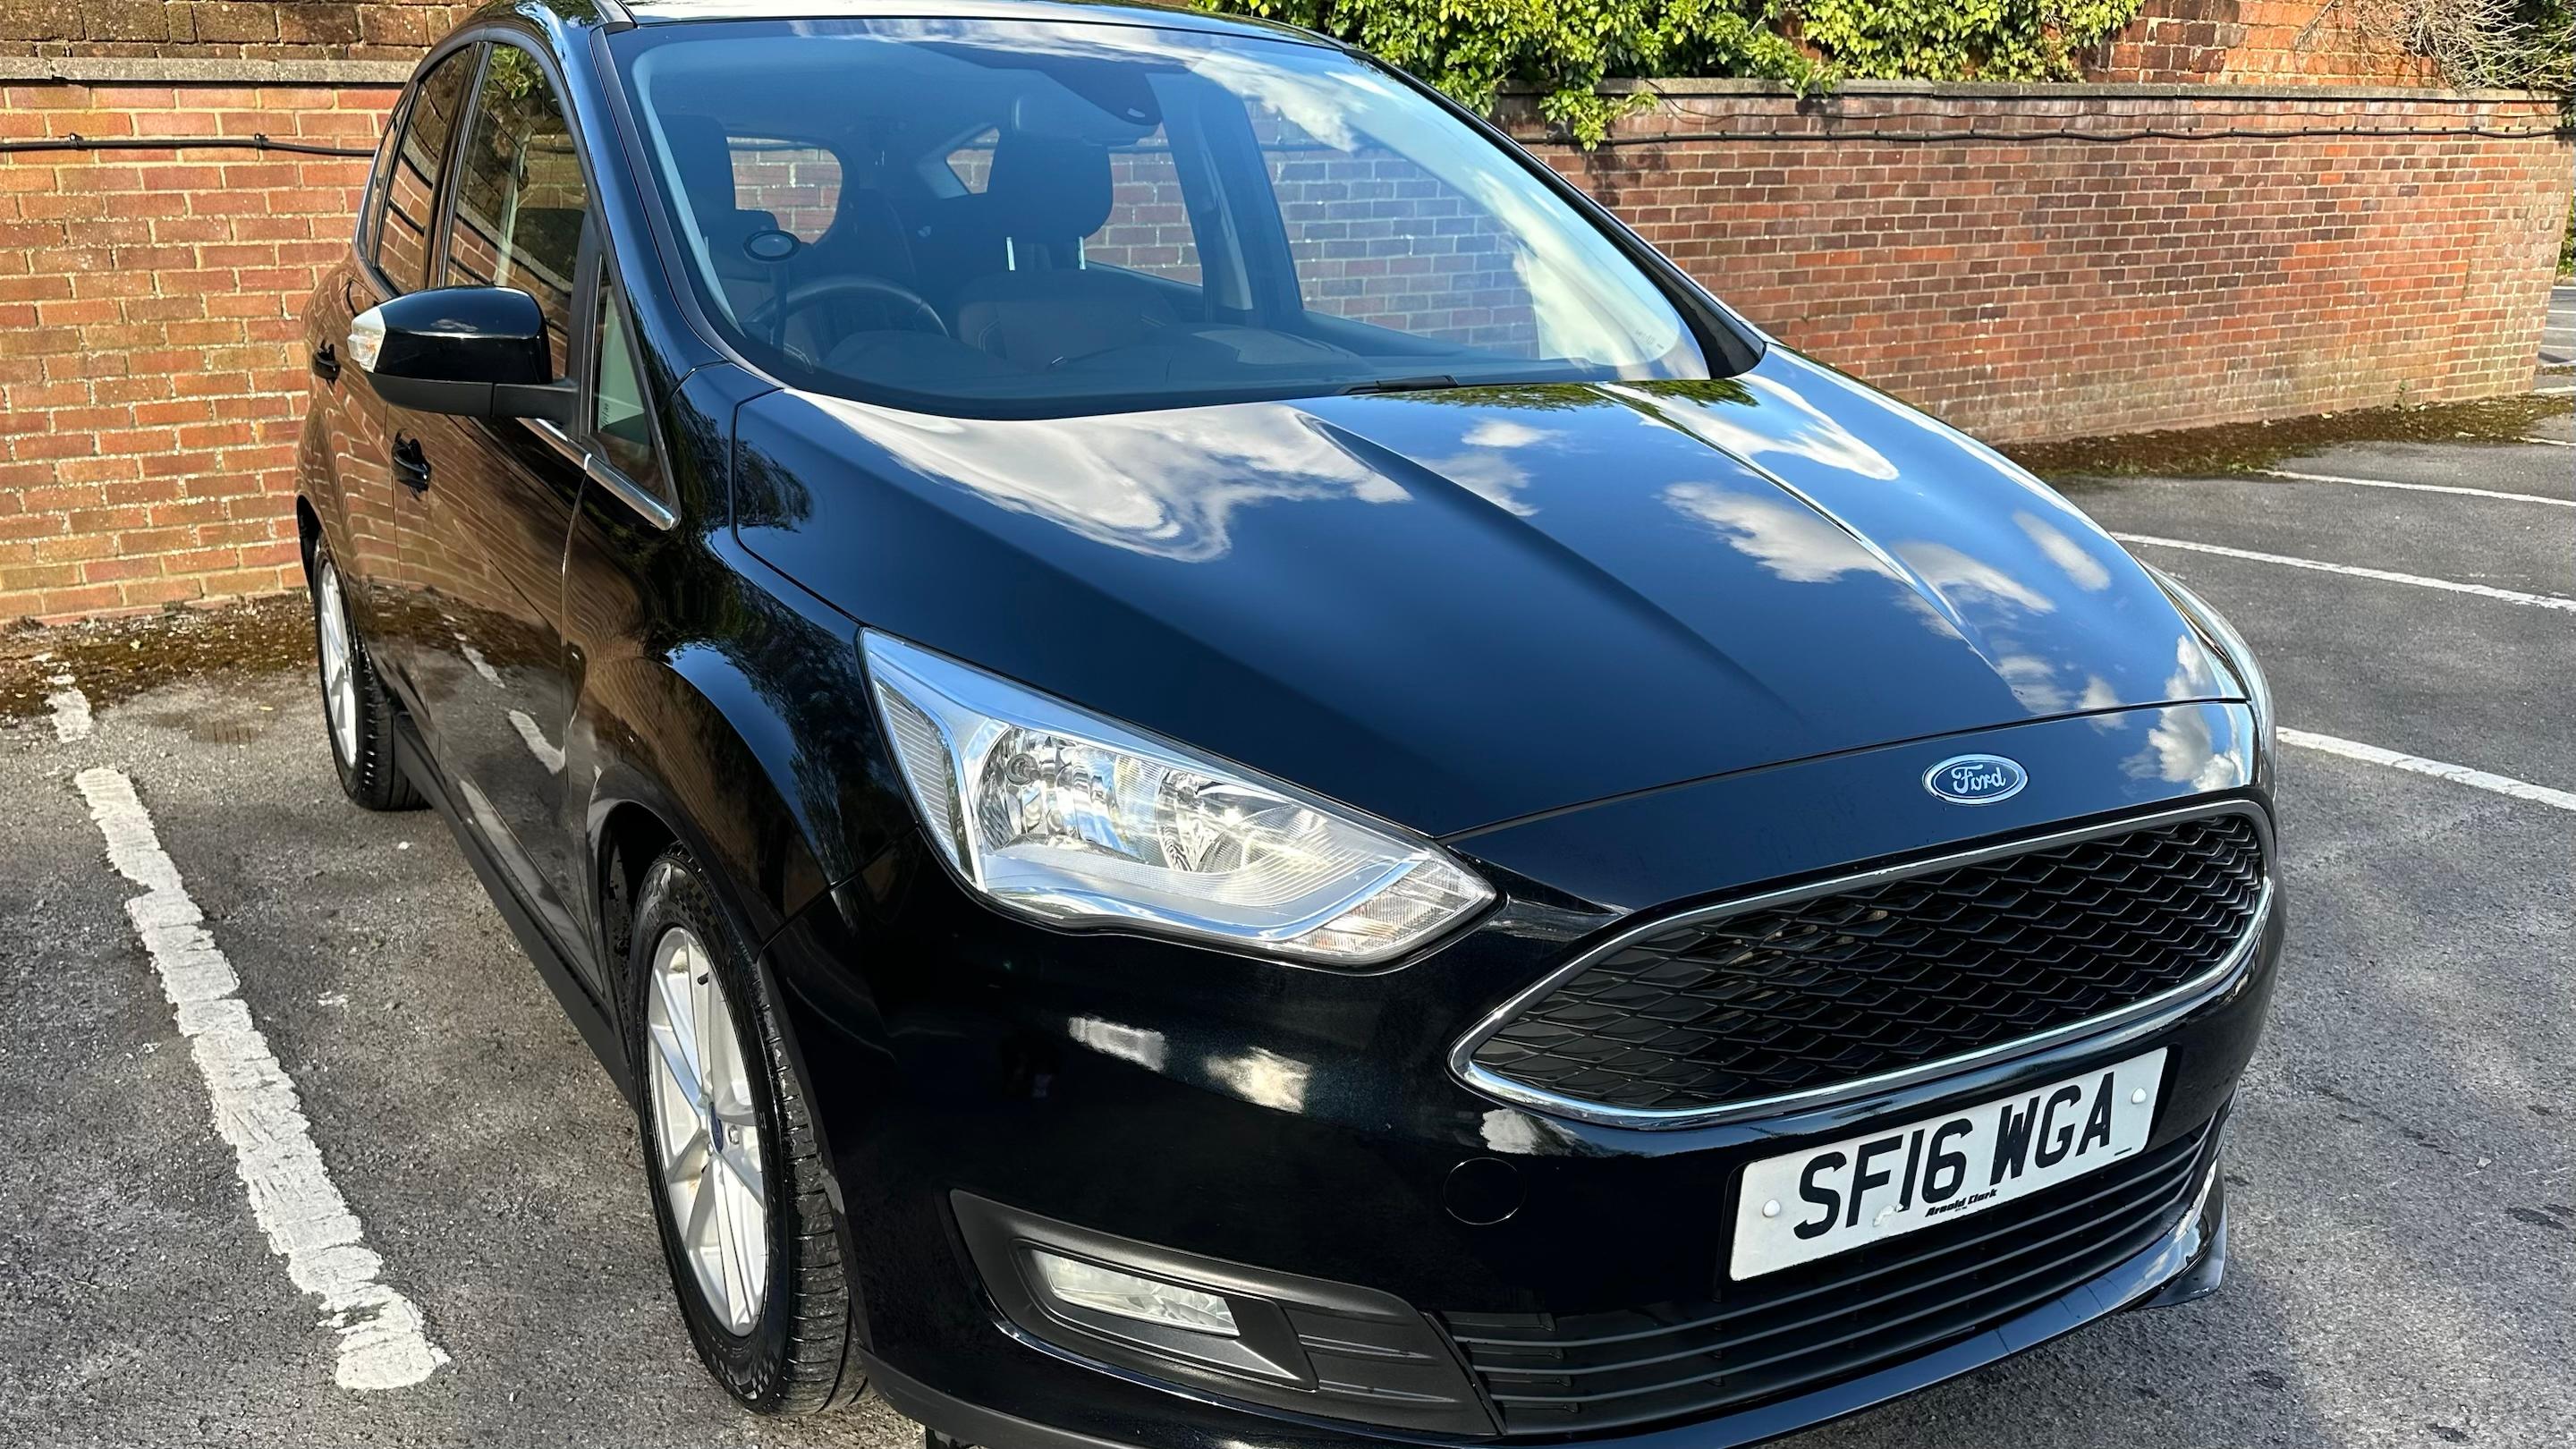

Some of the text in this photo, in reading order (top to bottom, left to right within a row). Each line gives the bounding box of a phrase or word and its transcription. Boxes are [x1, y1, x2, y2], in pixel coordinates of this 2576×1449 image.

[1951, 764, 2006, 794] Ford
[1793, 1072, 2114, 1241] SF16 WGA
[1925, 1189, 1997, 1217] Arnold Clark
